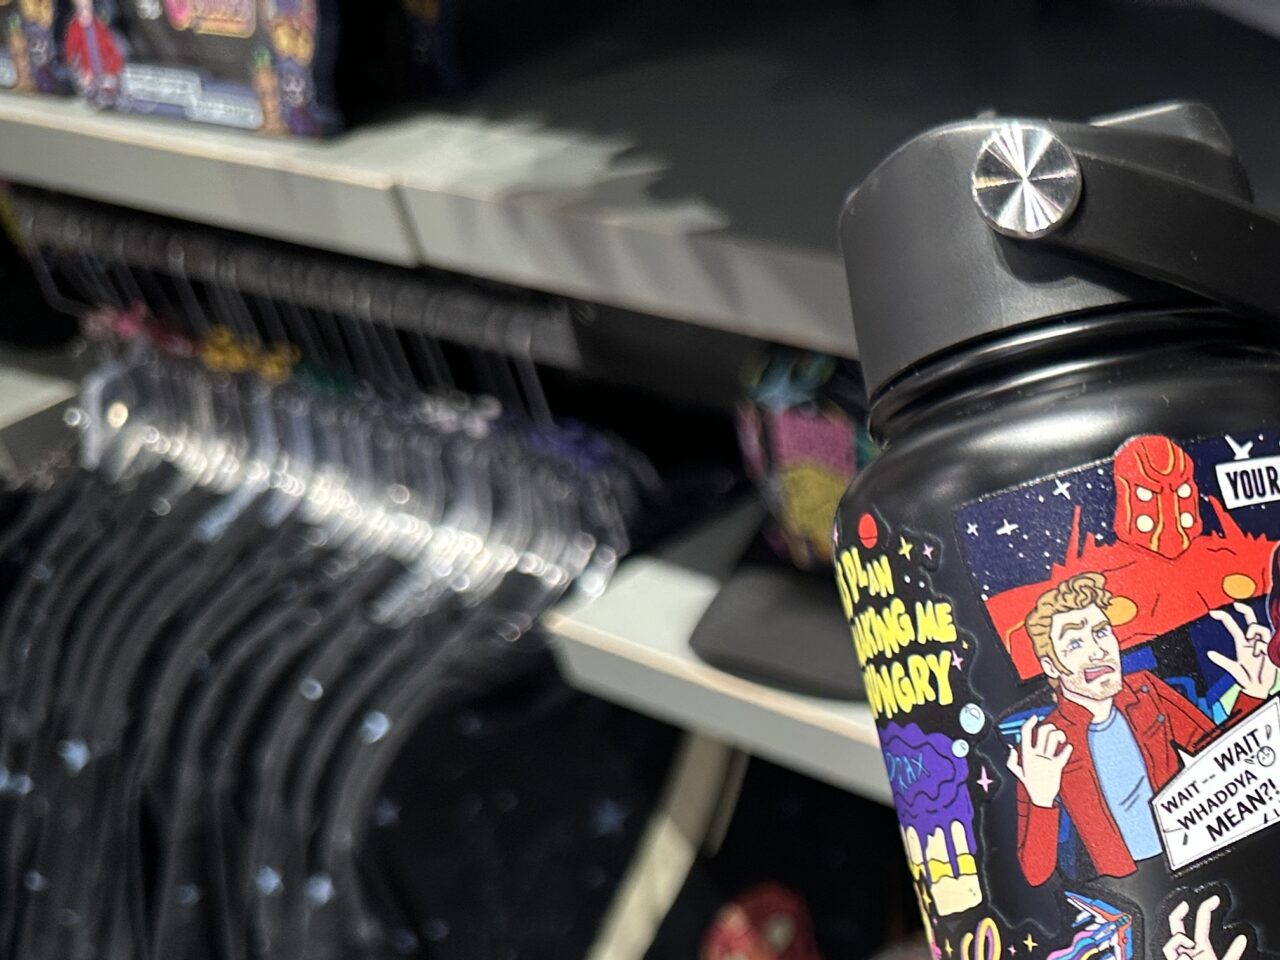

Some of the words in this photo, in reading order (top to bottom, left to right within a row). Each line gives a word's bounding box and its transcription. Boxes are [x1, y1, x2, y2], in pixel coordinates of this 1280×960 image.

[916, 600, 957, 644] ME
[1177, 769, 1259, 830] WHADDYA
[1206, 778, 1280, 842] MEAN?!
